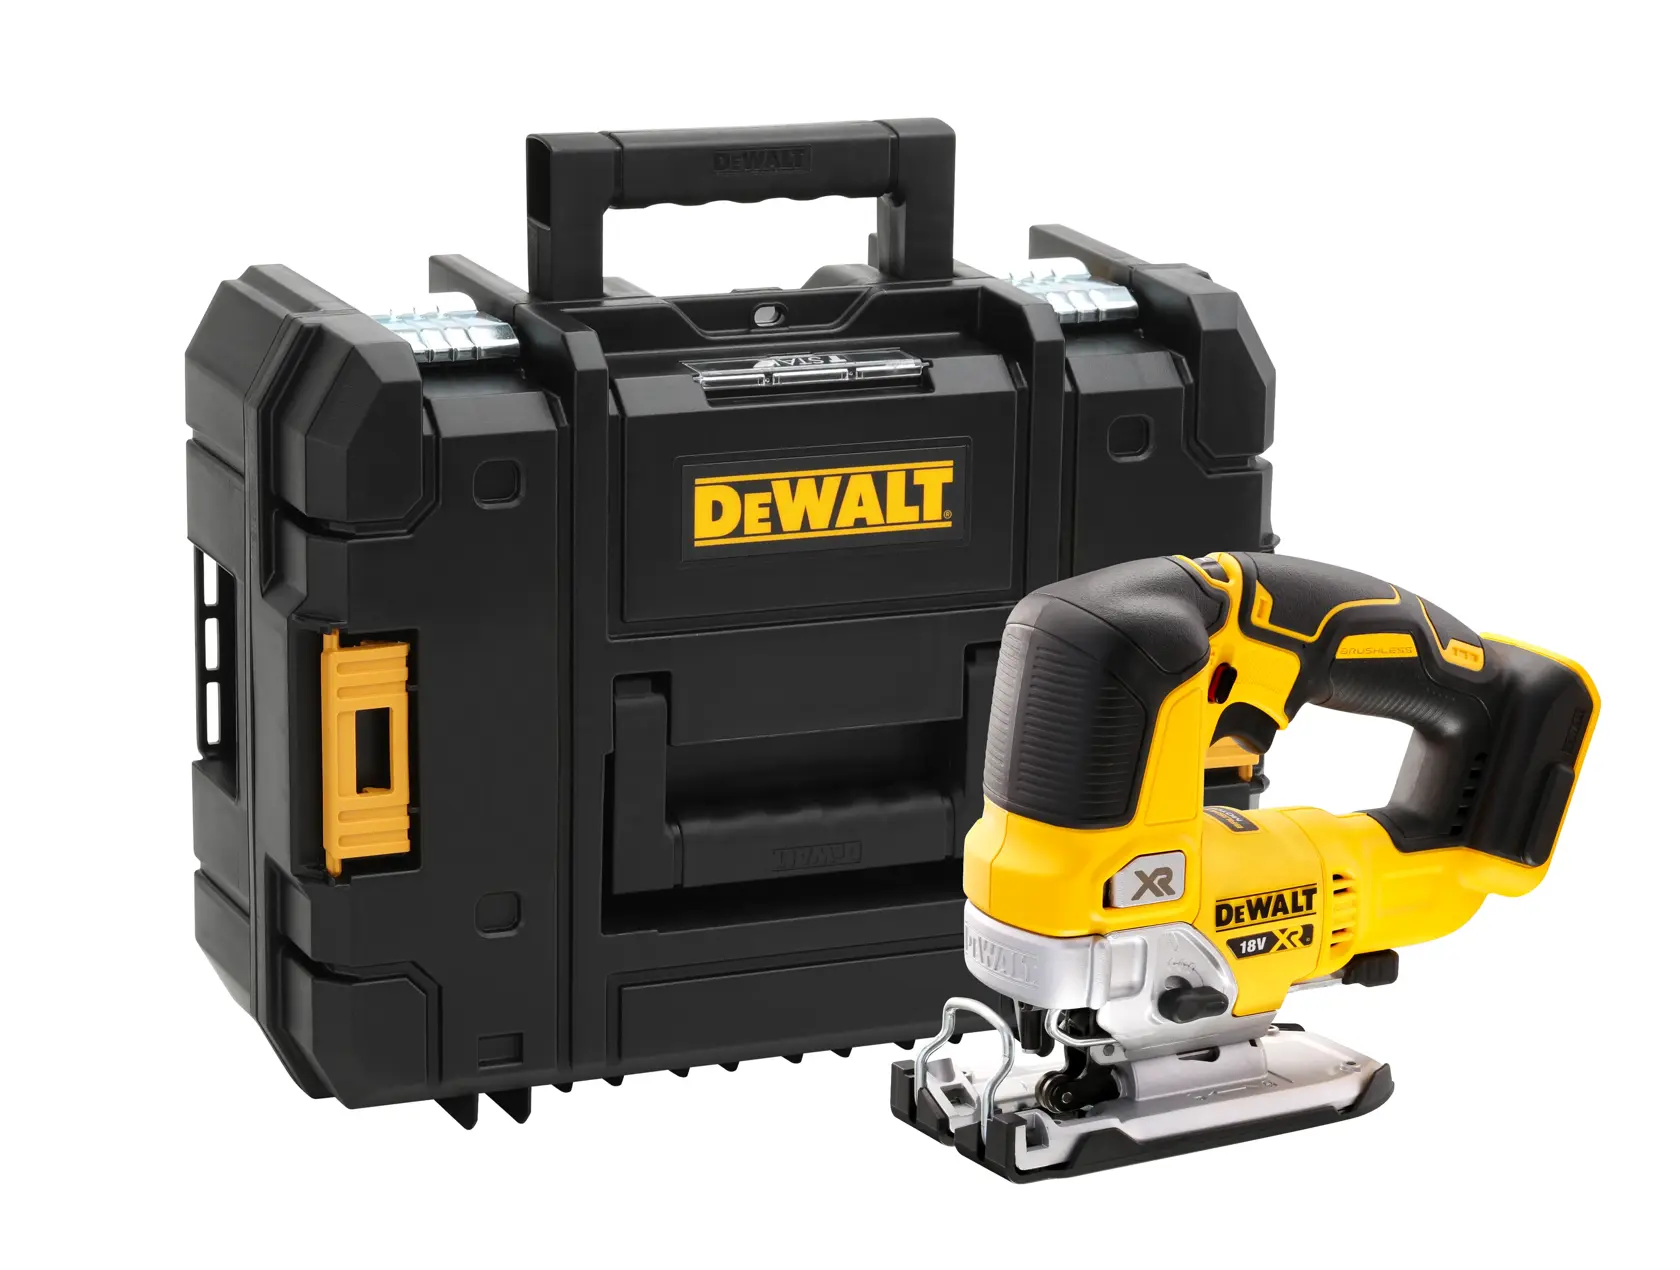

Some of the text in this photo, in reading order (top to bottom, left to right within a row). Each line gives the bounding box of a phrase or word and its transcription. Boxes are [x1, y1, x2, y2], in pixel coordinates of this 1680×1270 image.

[1340, 646, 1413, 655] BRUSHLESS
[1131, 866, 1176, 902] XR
[1239, 925, 1304, 955] 18V XR
